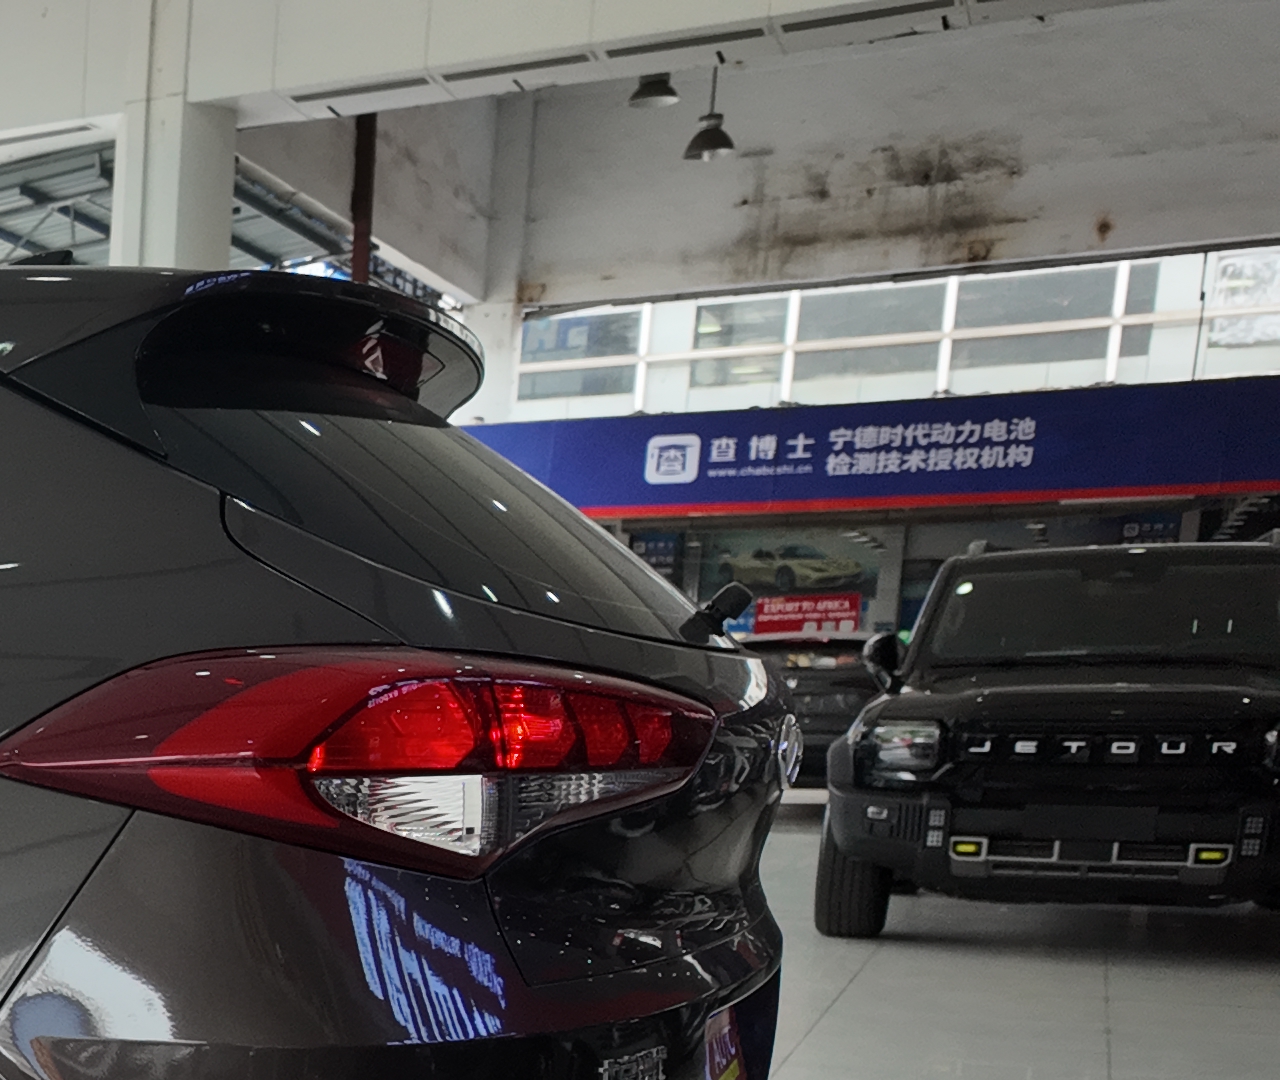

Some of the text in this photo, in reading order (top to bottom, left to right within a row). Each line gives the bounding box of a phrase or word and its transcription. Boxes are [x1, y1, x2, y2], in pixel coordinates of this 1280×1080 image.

[709, 433, 816, 462] 查博士
[828, 416, 1037, 451] 宁德时代动力电池
[826, 443, 1034, 477] 检测技术授权机构
[968, 740, 1237, 754] JETOUR
